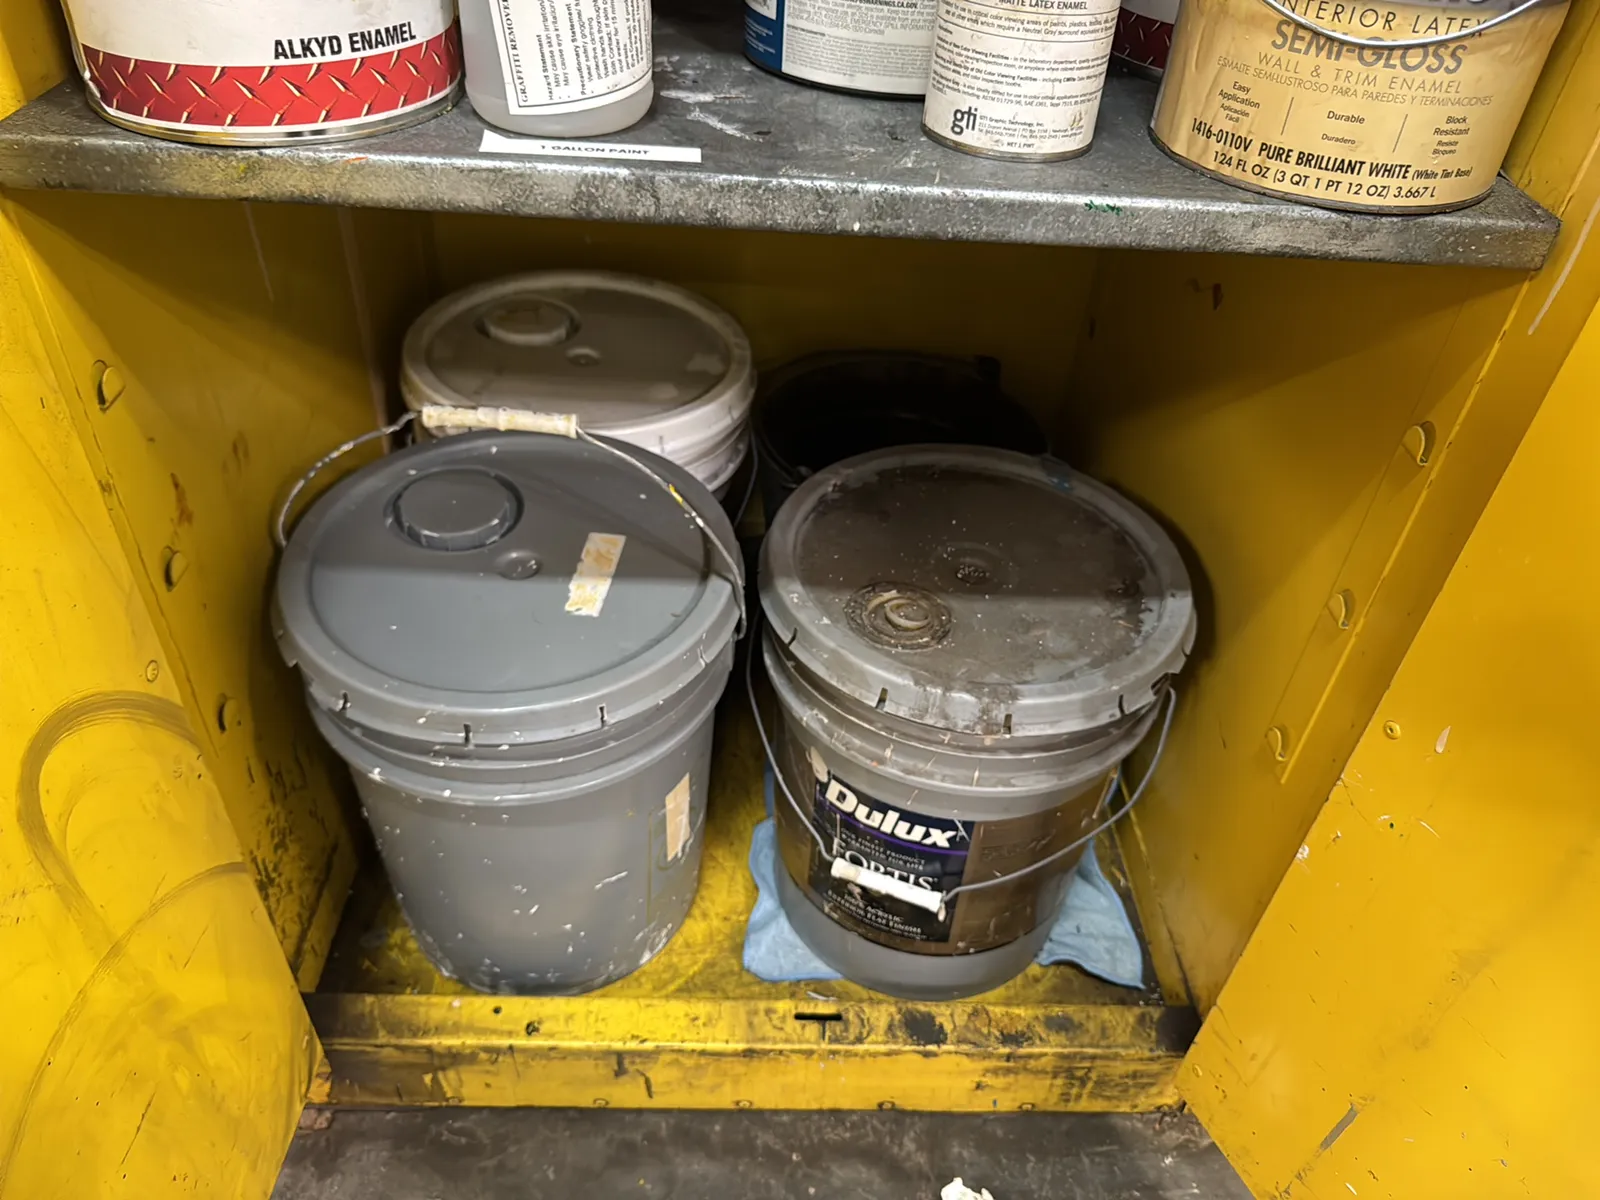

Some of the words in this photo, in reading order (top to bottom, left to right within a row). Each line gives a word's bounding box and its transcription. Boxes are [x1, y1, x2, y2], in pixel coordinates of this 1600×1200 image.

[601, 6, 609, 22] skin
[1029, 0, 1055, 9] LATEX
[1057, 1, 1087, 10] ENAMEL
[565, 3, 578, 43] Statement
[612, 16, 618, 25] 15
[1004, 17, 1024, 25] viewing
[1276, 0, 1396, 31] NTERIOR
[274, 34, 342, 60] ALKYD
[348, 21, 416, 53] ENAMEL
[544, 33, 553, 48] skin
[555, 33, 563, 47] eye
[587, 17, 597, 46] clothing
[536, 34, 549, 73] Statement
[581, 41, 590, 62] safety
[597, 36, 606, 58] hands
[1271, 19, 1468, 75] SEMI-GLOSS
[549, 50, 558, 71] cause
[557, 49, 567, 71] cause
[593, 47, 603, 80] protective
[971, 48, 988, 58] Viewing
[989, 52, 1009, 60] Facilities
[1029, 57, 1053, 65] laboratory
[573, 44, 587, 95] Precautionary
[601, 58, 609, 78] Wash
[609, 60, 617, 75] Skin
[1258, 51, 1300, 75] WALL
[1311, 64, 1321, 79] &
[1335, 68, 1378, 88] TRIM
[1388, 76, 1461, 94] ENAMEL
[512, 53, 528, 103] GRAFFITI
[543, 74, 554, 100] Hazard
[553, 73, 561, 87] May
[562, 72, 570, 86] May
[981, 76, 1004, 85] inspection
[997, 72, 1016, 81] Viewing
[1042, 76, 1062, 84] including
[1217, 56, 1250, 76] ESMALTE
[1331, 85, 1358, 99] PARA
[1361, 90, 1407, 105] PAREDES
[1410, 95, 1418, 105] Y
[1419, 95, 1494, 107] TERMINACIONES
[1232, 81, 1251, 95] Easy
[1218, 89, 1260, 109] Application
[1220, 103, 1250, 118] Aplicación
[1327, 110, 1365, 125] Durable
[951, 106, 978, 136] gti
[989, 117, 1006, 125] Graphic
[1445, 115, 1468, 125] Block
[1321, 133, 1356, 145] Duradero
[1433, 127, 1470, 136] Resistant
[1191, 118, 1253, 152] 1416-0110V
[1258, 142, 1294, 164] PURE
[1295, 151, 1366, 176] BRILLIANT
[1368, 162, 1412, 180] WHITE
[1412, 169, 1438, 181] (White
[1440, 169, 1453, 179] Tint
[1454, 166, 1473, 178] Base)
[1432, 148, 1457, 156] Bloqueo
[1436, 140, 1459, 148] Resiste
[1213, 151, 1233, 168] 124
[1235, 159, 1248, 173] FL
[1251, 164, 1271, 179] OZ
[1273, 169, 1287, 183] (3
[1290, 174, 1310, 187] QT
[1314, 178, 1322, 189] 1
[1325, 179, 1343, 193] PT
[1346, 182, 1363, 195] 12
[1366, 184, 1390, 200] OZ)
[1393, 186, 1428, 199] 3.667
[1430, 186, 1436, 197] L
[825, 778, 957, 848] Dulux
[886, 850, 925, 866] PRODUCT
